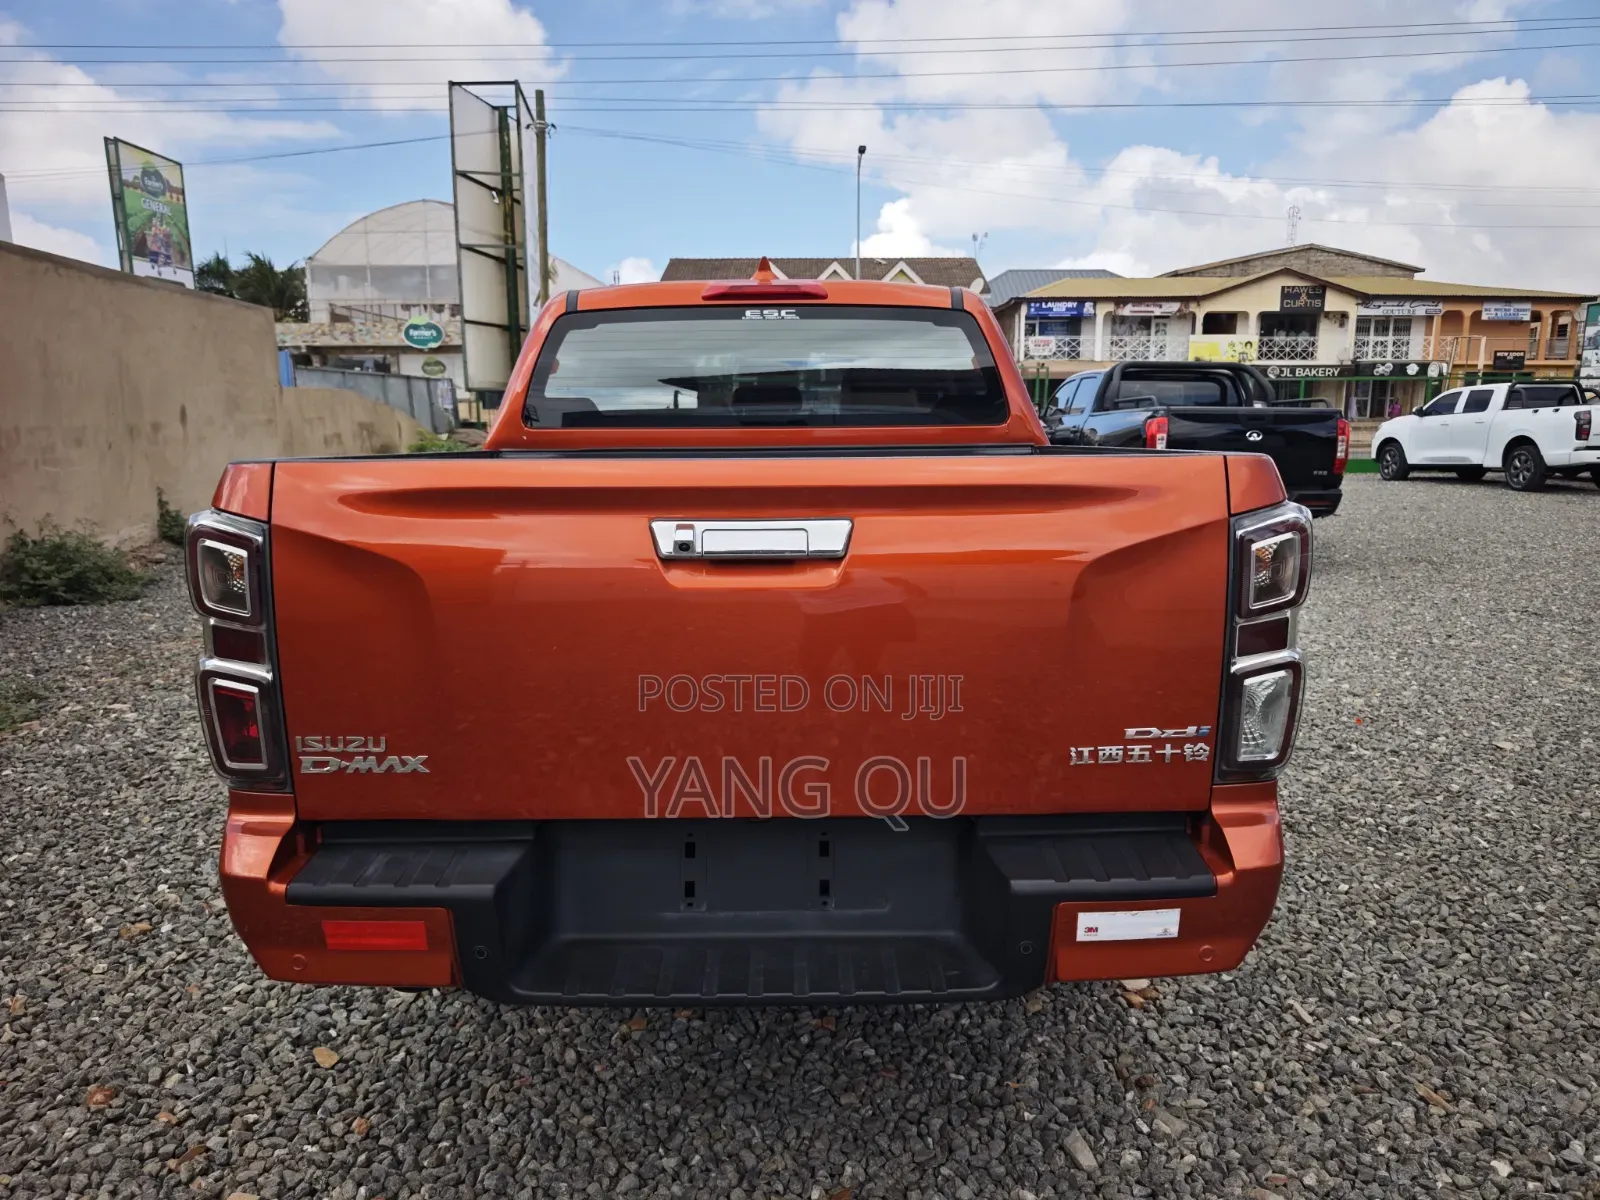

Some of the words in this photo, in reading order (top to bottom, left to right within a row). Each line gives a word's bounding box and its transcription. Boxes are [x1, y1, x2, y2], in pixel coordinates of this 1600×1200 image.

[1284, 286, 1322, 294] HAWES
[1283, 300, 1322, 308] CURTIS
[745, 309, 796, 317] ESC
[1280, 368, 1293, 377] JL
[1296, 367, 1340, 377] BAKERY
[295, 736, 386, 752] ISUZU
[1069, 743, 1211, 765] 江西五十铃
[299, 755, 430, 774] D-MAX
